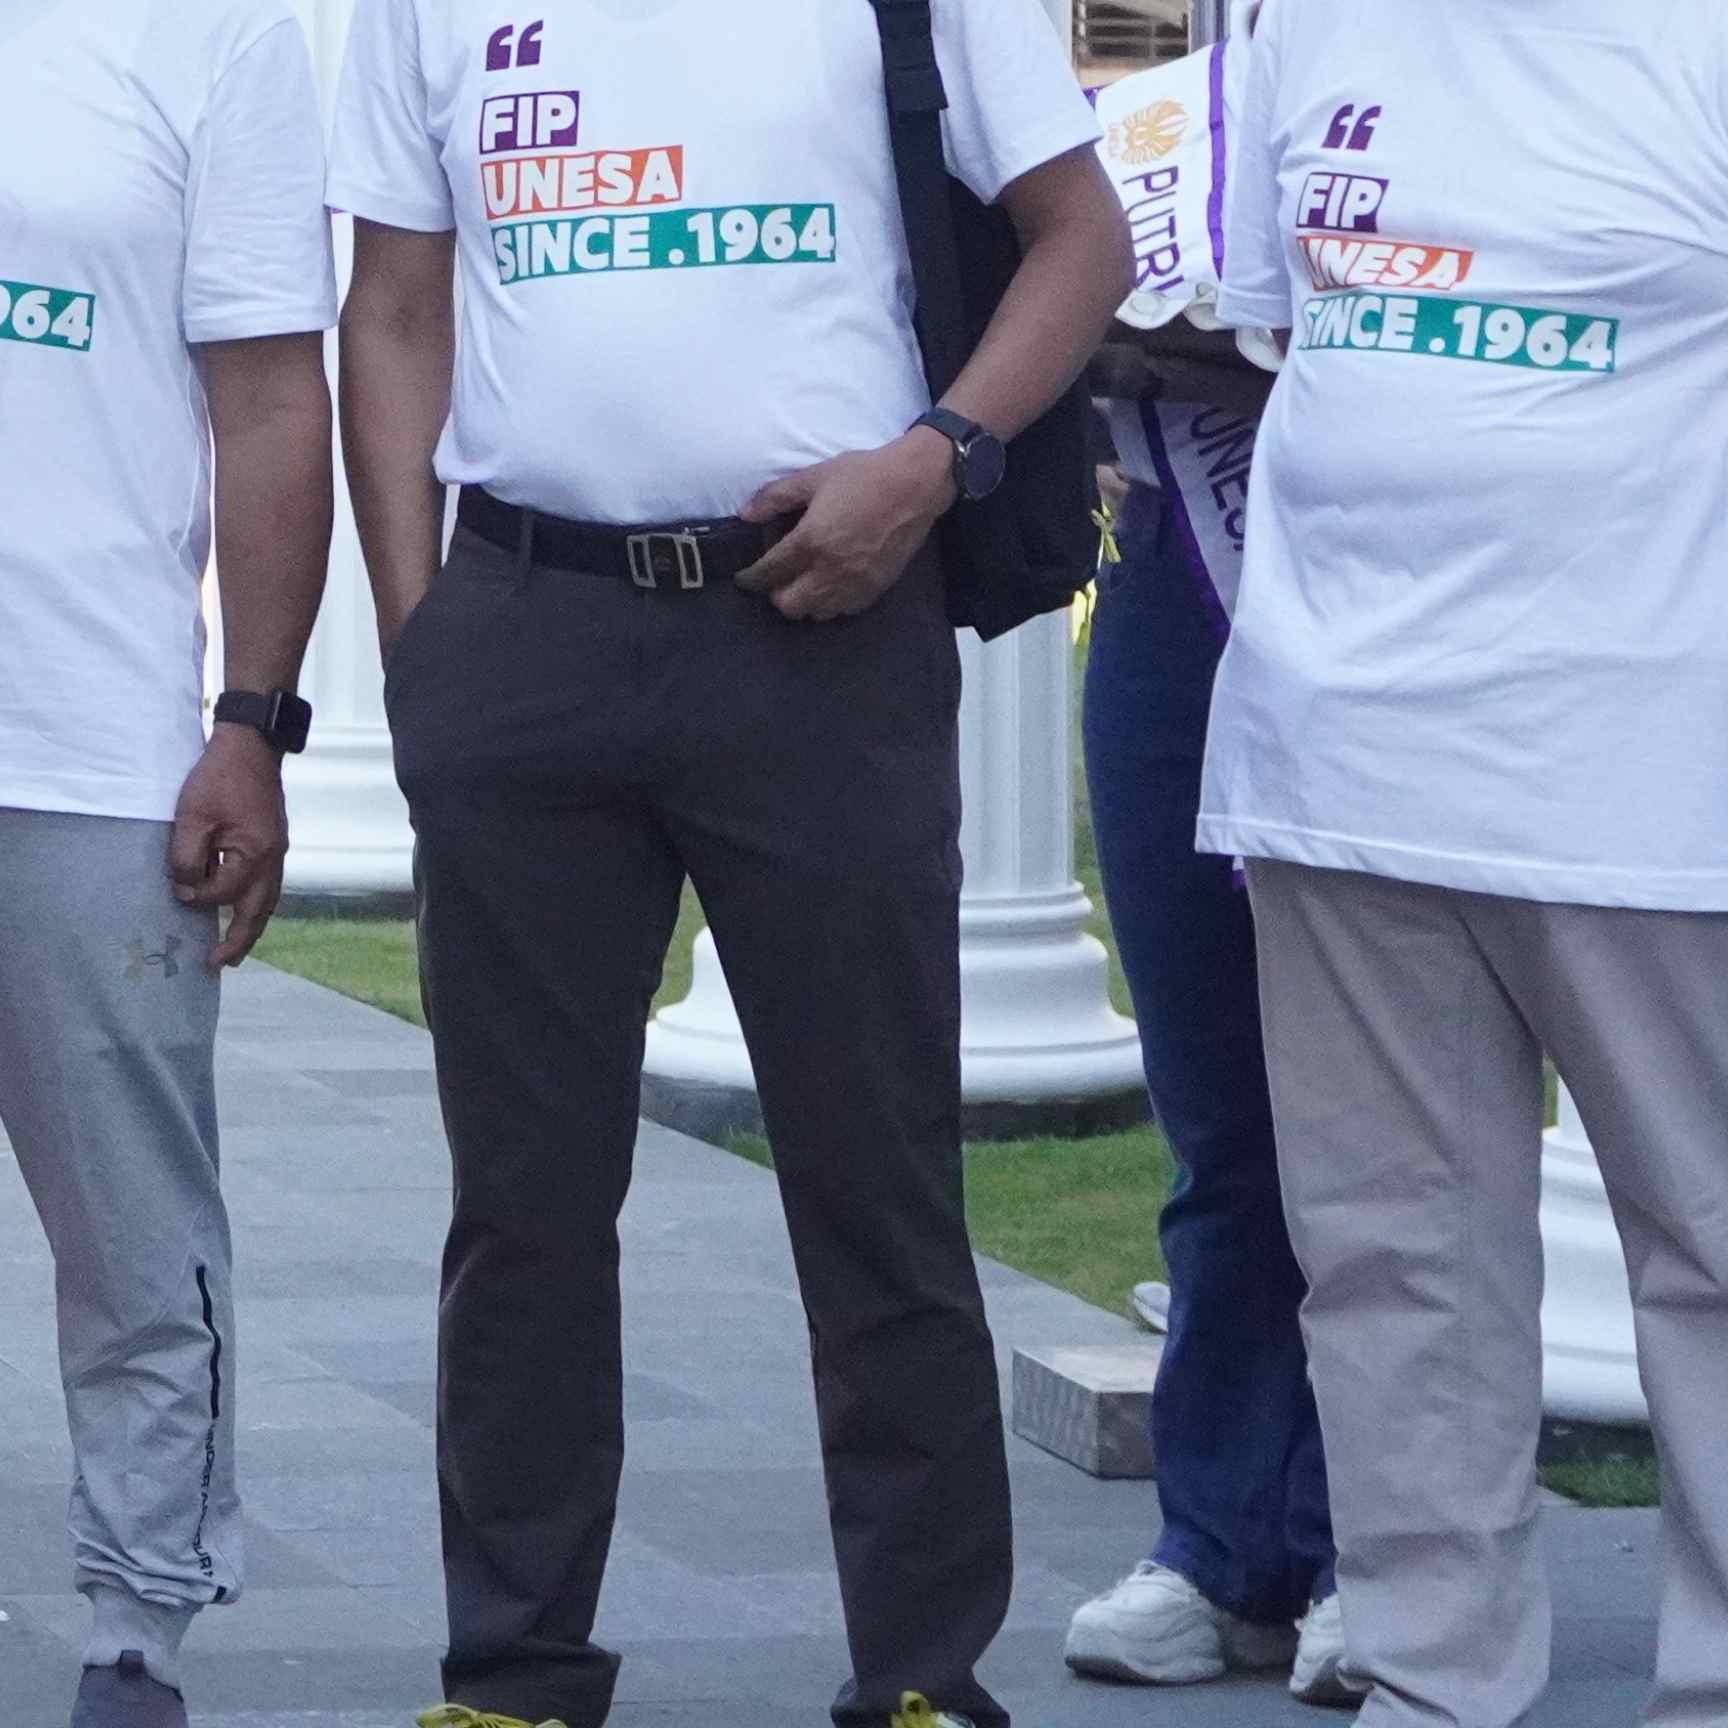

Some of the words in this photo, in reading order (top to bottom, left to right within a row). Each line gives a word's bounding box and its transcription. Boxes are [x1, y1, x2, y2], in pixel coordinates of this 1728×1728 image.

[481, 93, 577, 151] FIP
[485, 150, 680, 217] UNESA
[1297, 174, 1383, 228] FIP
[495, 219, 650, 281] SINCE
[1121, 165, 1185, 294] PUTRI
